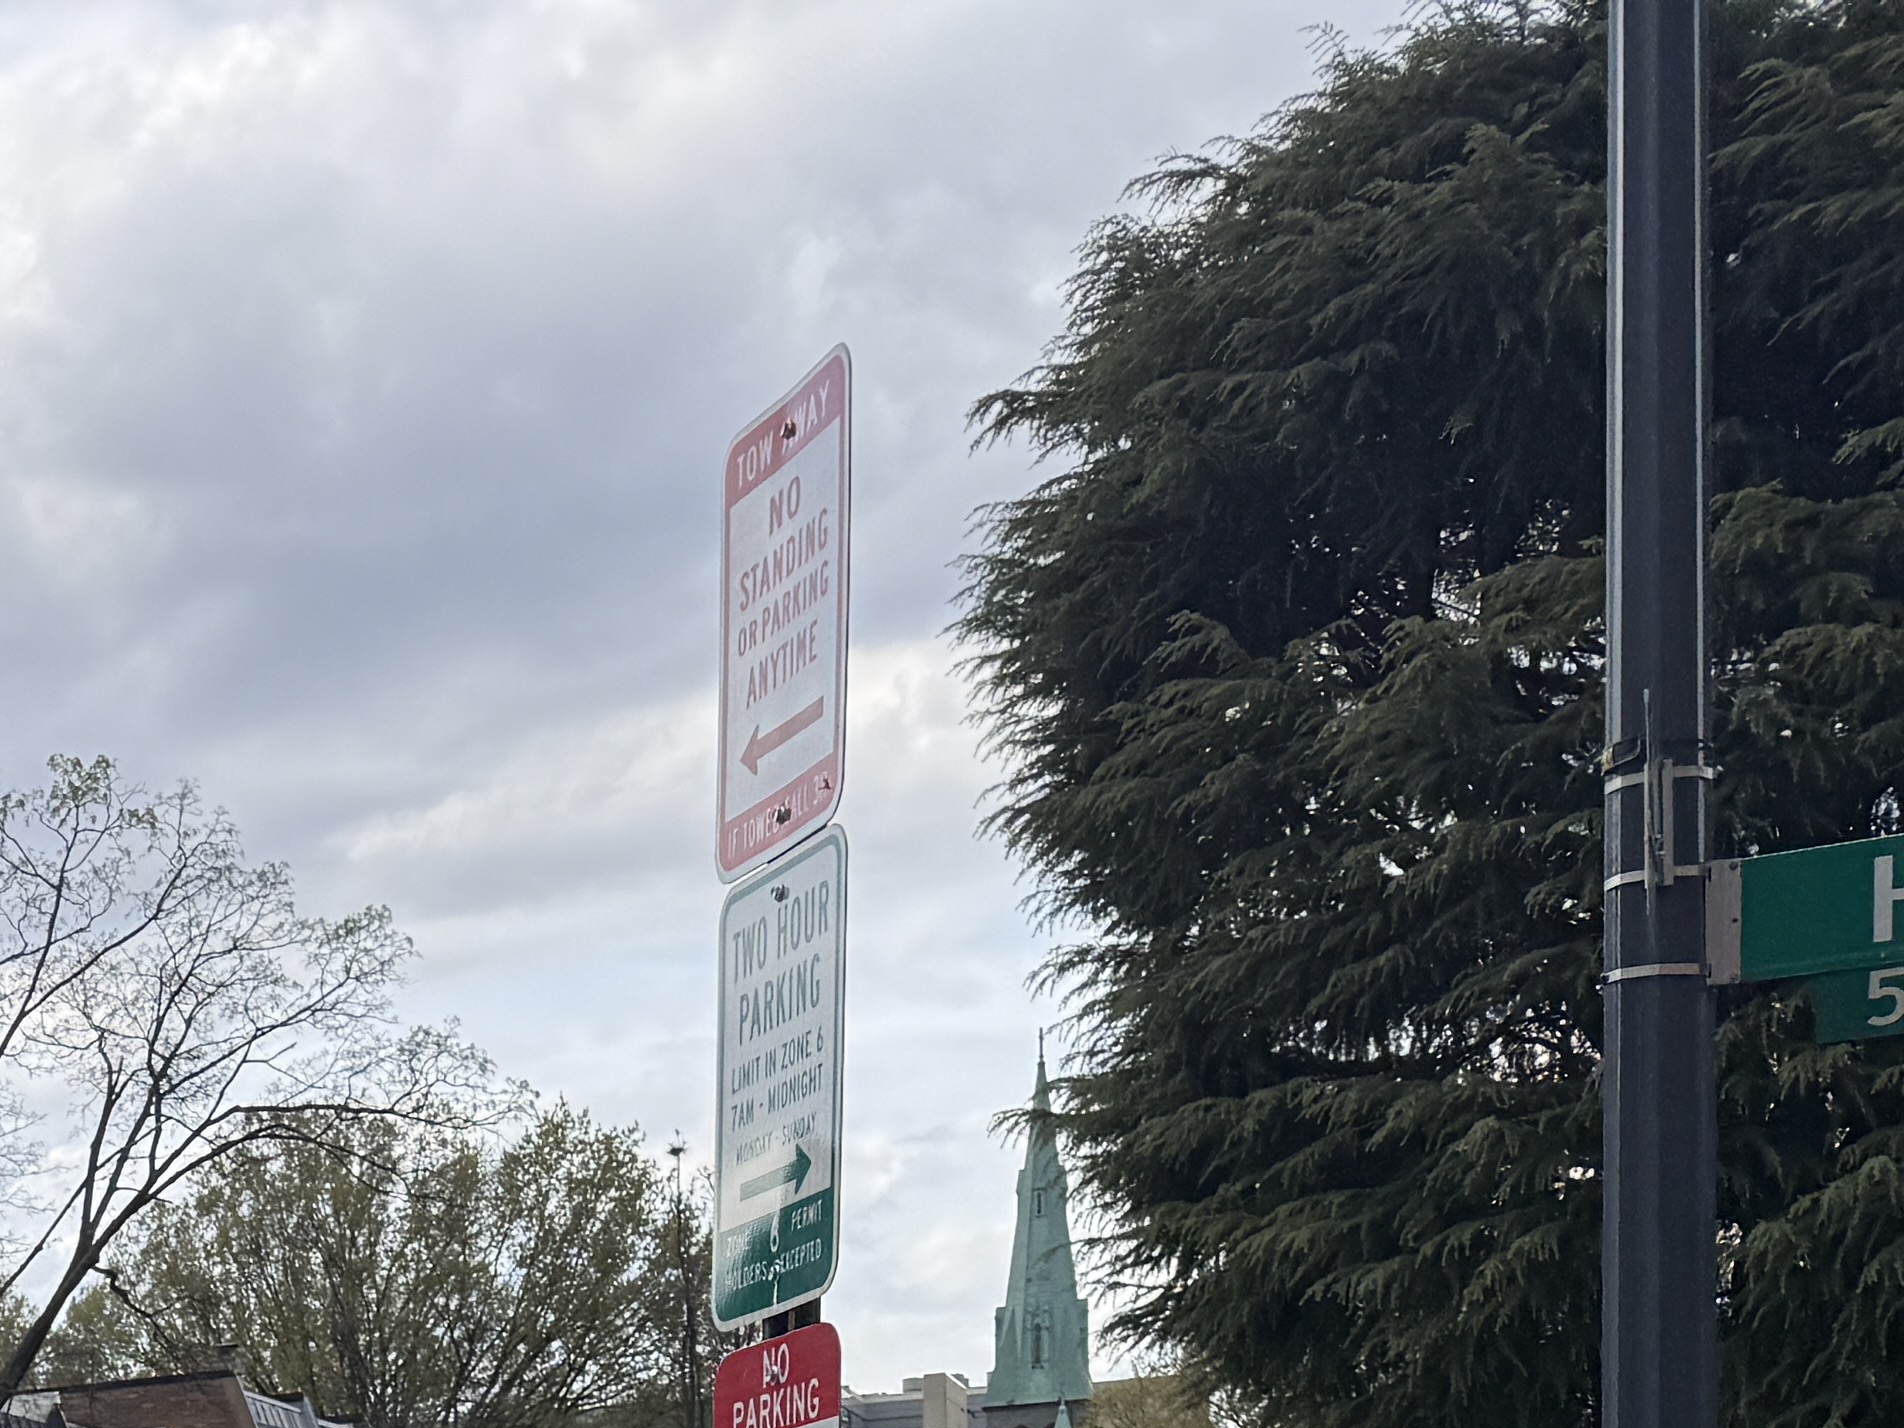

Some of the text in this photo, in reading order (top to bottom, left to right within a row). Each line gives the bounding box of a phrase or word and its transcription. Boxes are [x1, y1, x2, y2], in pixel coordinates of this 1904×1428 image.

[736, 378, 830, 491] TOW AWAY
[768, 475, 801, 537] NO
[739, 507, 829, 612] STANDING
[738, 560, 830, 657] OR PARKING
[746, 619, 818, 709] ANYTIME
[727, 826, 740, 860] IF
[733, 880, 829, 985] TWO HOUR
[739, 953, 820, 1047] PARKING
[732, 1025, 825, 1095] LIMIT IN ZONE 6
[731, 1097, 755, 1133] 7AM
[767, 1062, 824, 1114] MIDNIGHT
[782, 1111, 817, 1146] SUNDAY
[769, 1211, 780, 1253] 6
[790, 1198, 824, 1233] PERMIT
[780, 1237, 823, 1274] EXCEPTED
[762, 1342, 790, 1389] NO
